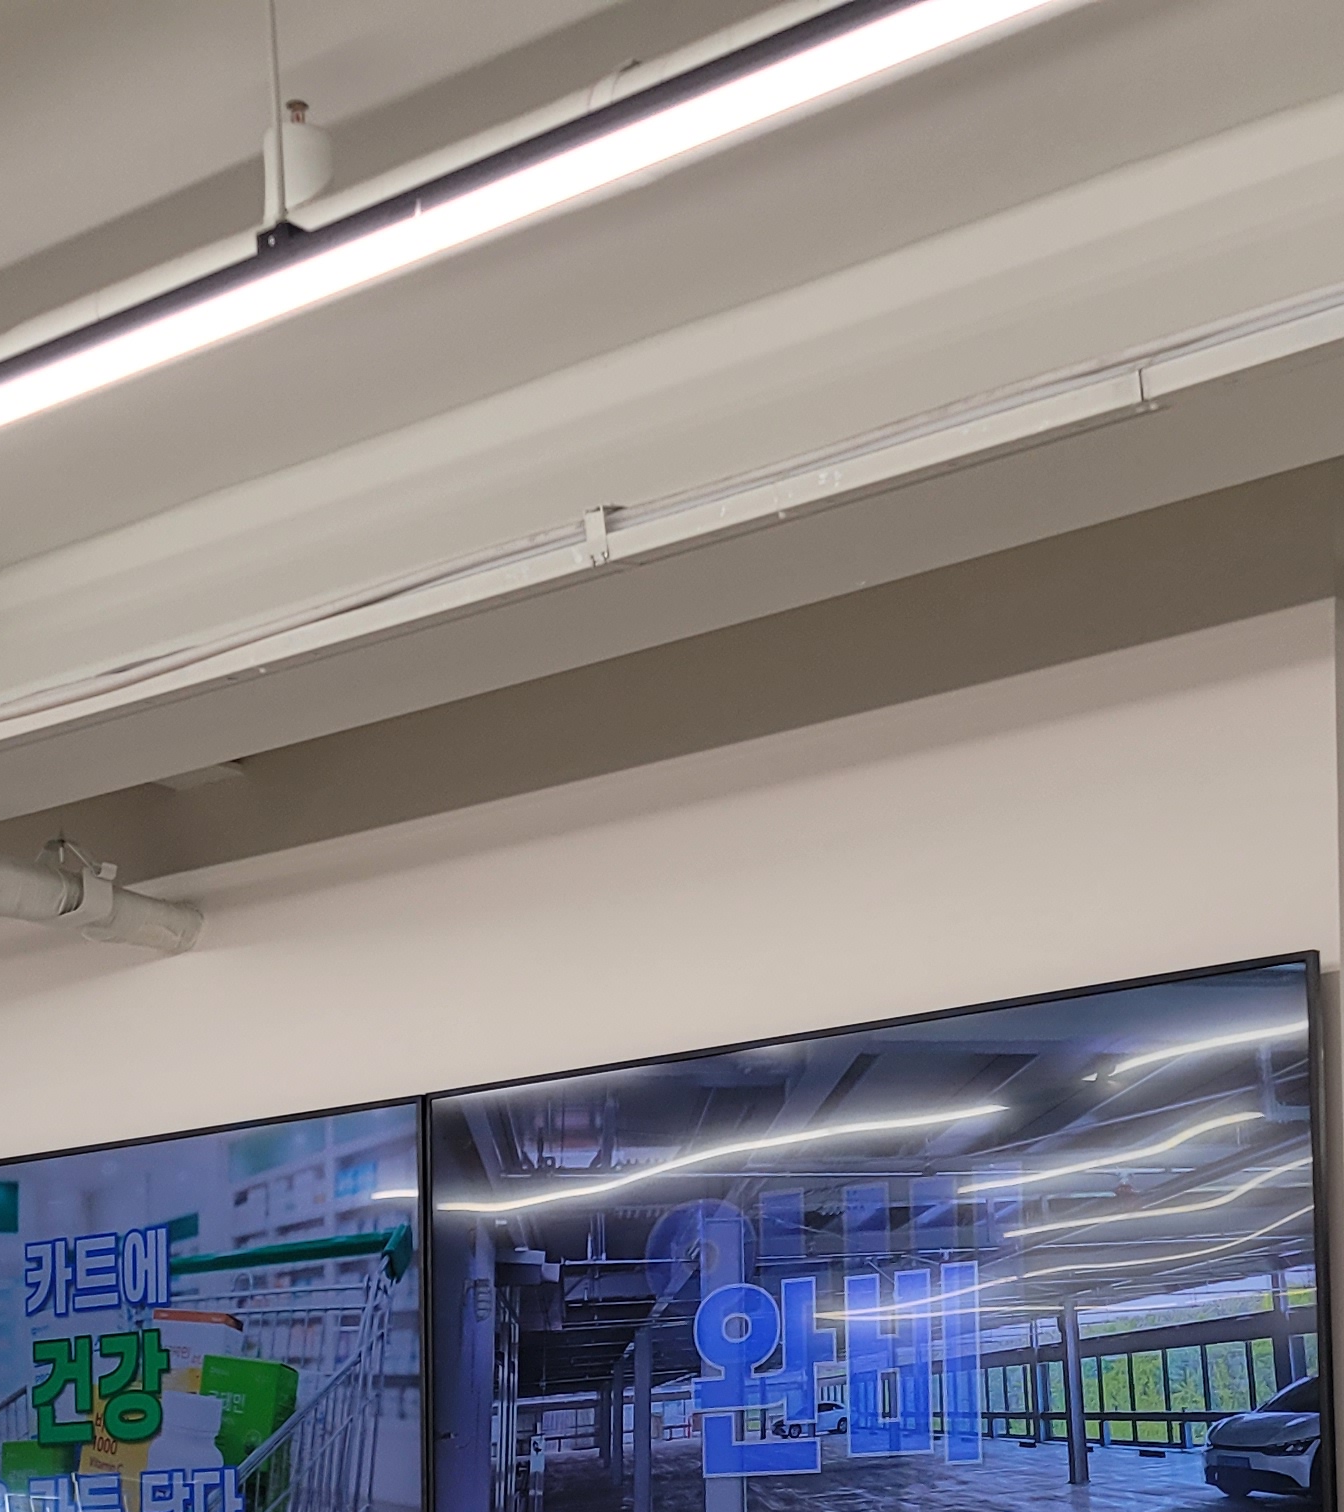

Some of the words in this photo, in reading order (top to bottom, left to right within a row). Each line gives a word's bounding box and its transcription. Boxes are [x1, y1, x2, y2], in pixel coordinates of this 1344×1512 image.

[23, 1224, 172, 1318] 카트에
[32, 1328, 170, 1445] 건강
[92, 1435, 118, 1455] 1000
